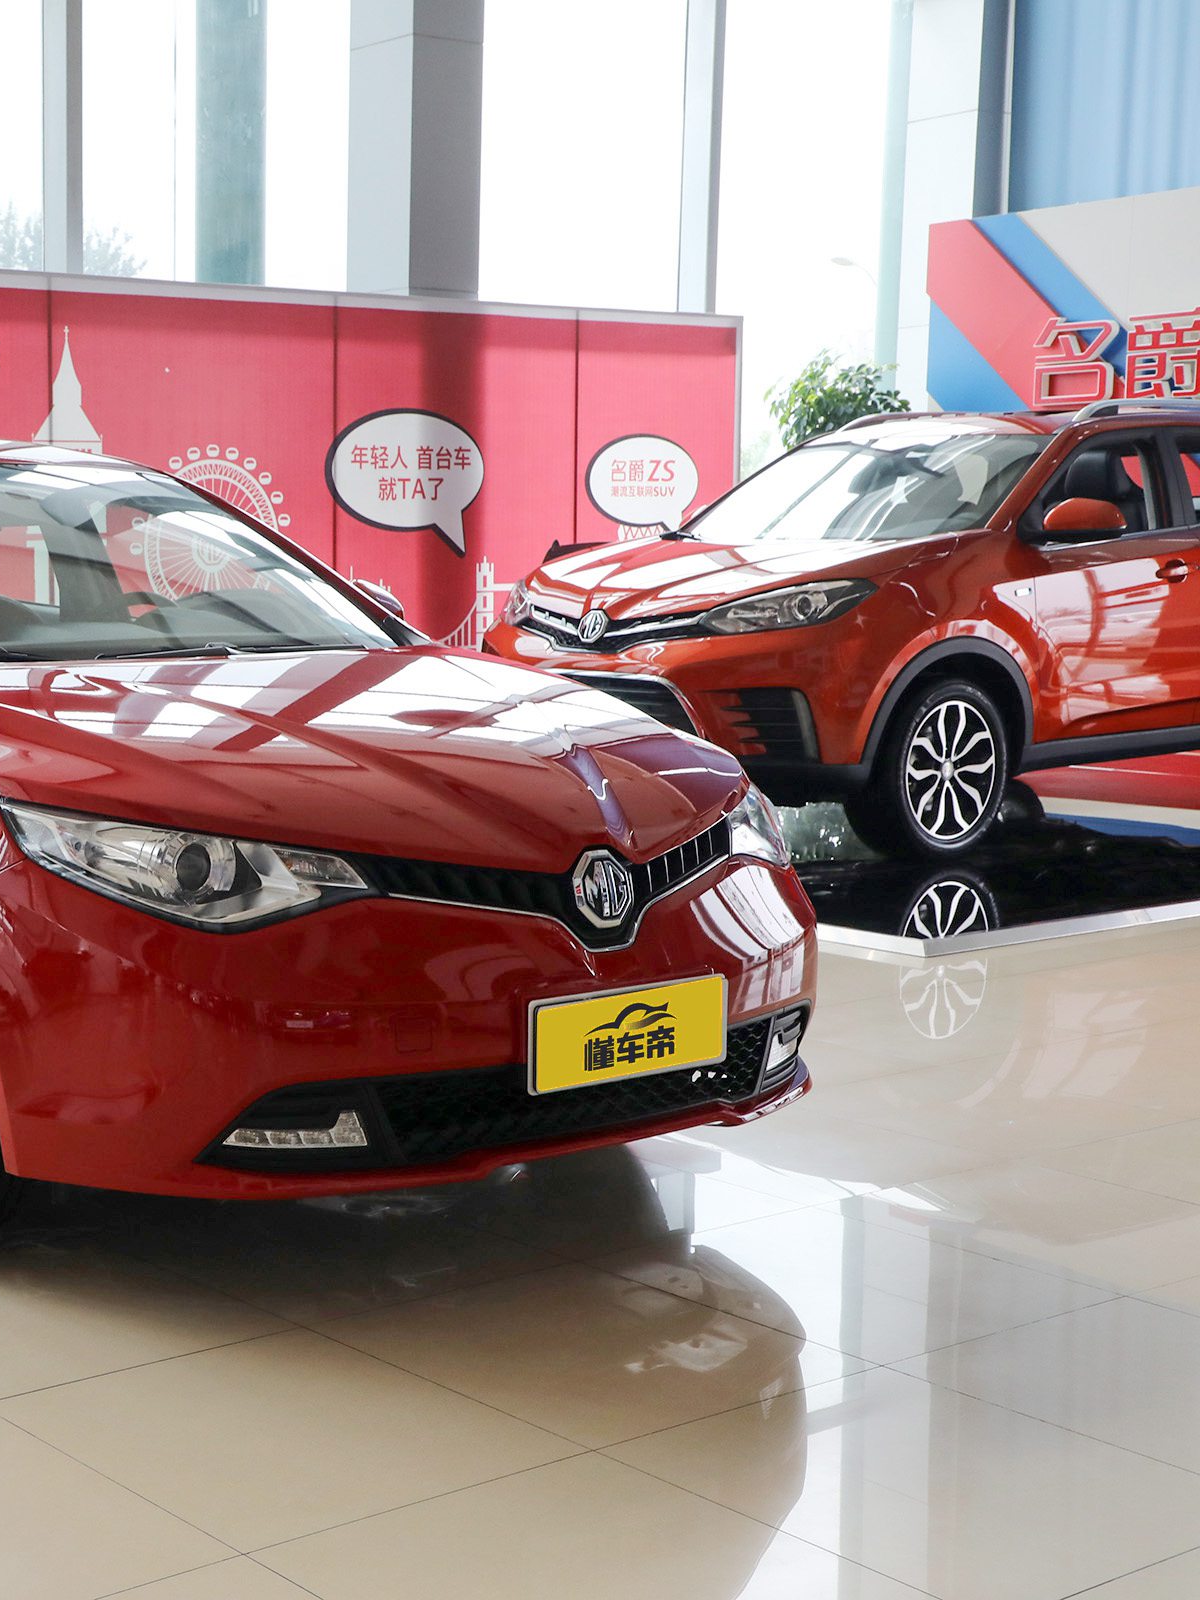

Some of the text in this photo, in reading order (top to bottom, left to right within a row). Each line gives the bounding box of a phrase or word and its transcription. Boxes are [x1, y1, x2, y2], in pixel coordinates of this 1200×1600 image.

[351, 445, 471, 470] 年轻人 首台车
[378, 477, 443, 500] 就TA了
[582, 857, 630, 921] MG
[584, 1025, 675, 1071] 懂车帝
